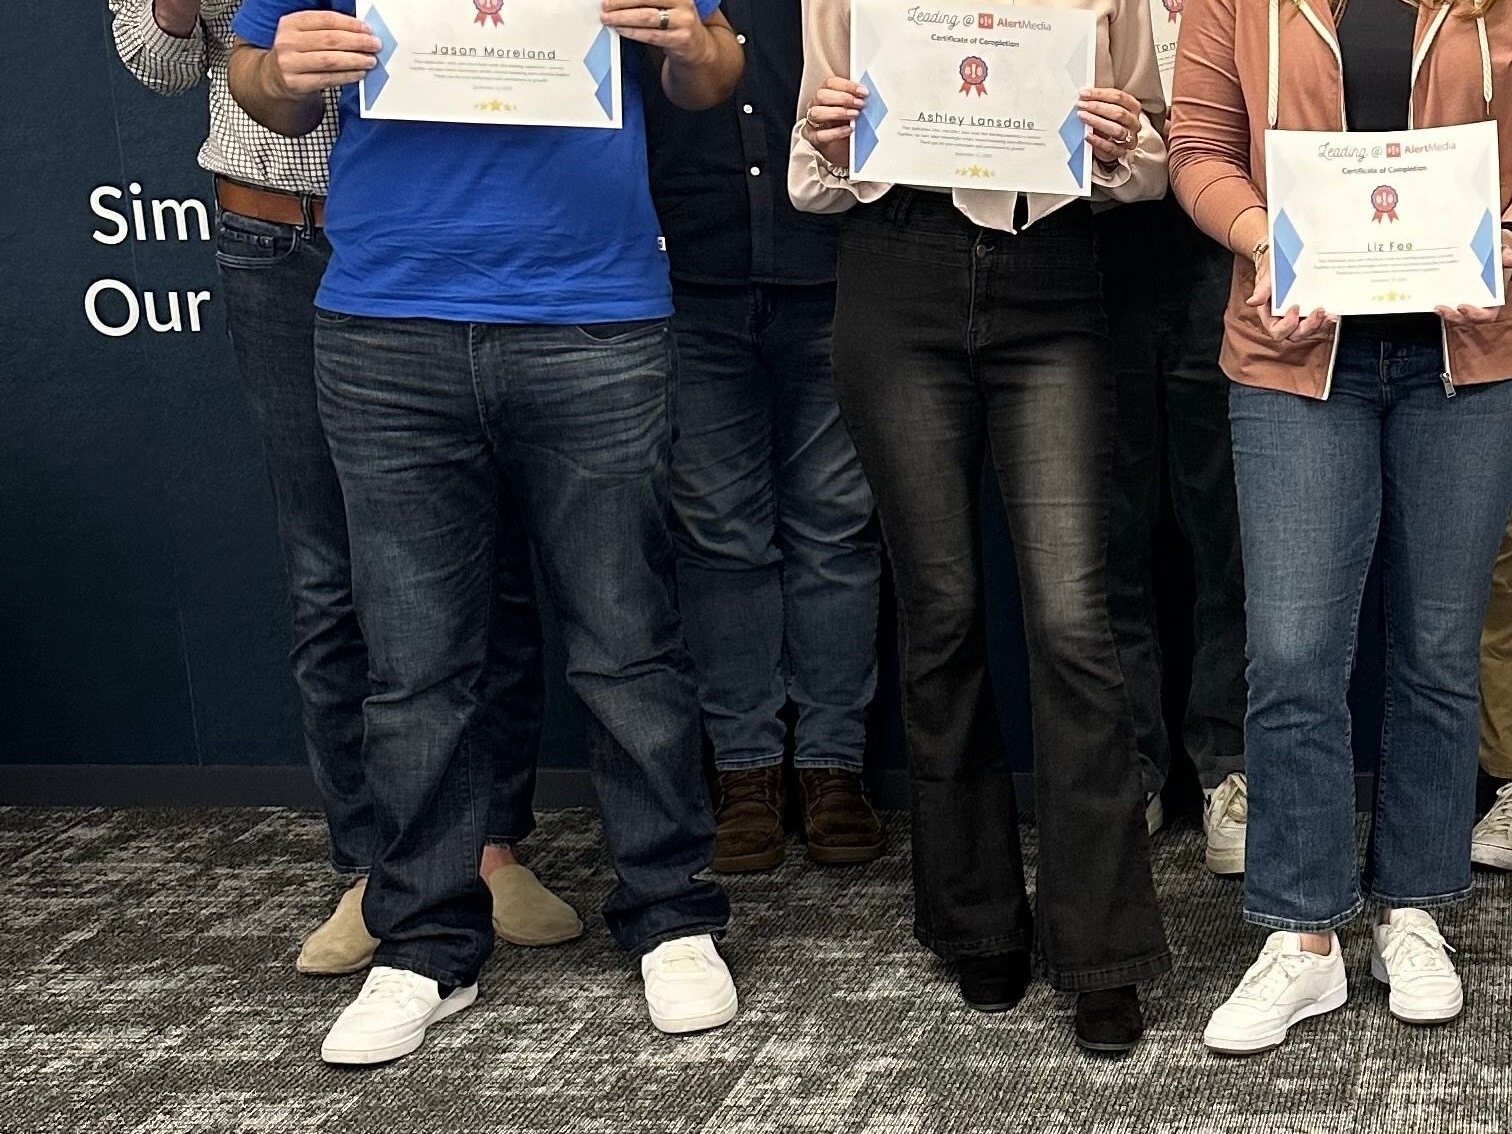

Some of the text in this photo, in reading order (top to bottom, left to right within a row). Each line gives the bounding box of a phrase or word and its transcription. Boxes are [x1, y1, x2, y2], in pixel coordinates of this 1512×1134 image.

[907, 6, 1051, 31] Leading @ AlertMedia
[432, 45, 556, 60] Jason Moreland
[918, 112, 1034, 129] Ashley Lansdale
[1318, 142, 1456, 162] Leading @ AlertMedia
[90, 182, 211, 245] Sim
[1367, 242, 1384, 251] Liz
[84, 278, 211, 337] Our
